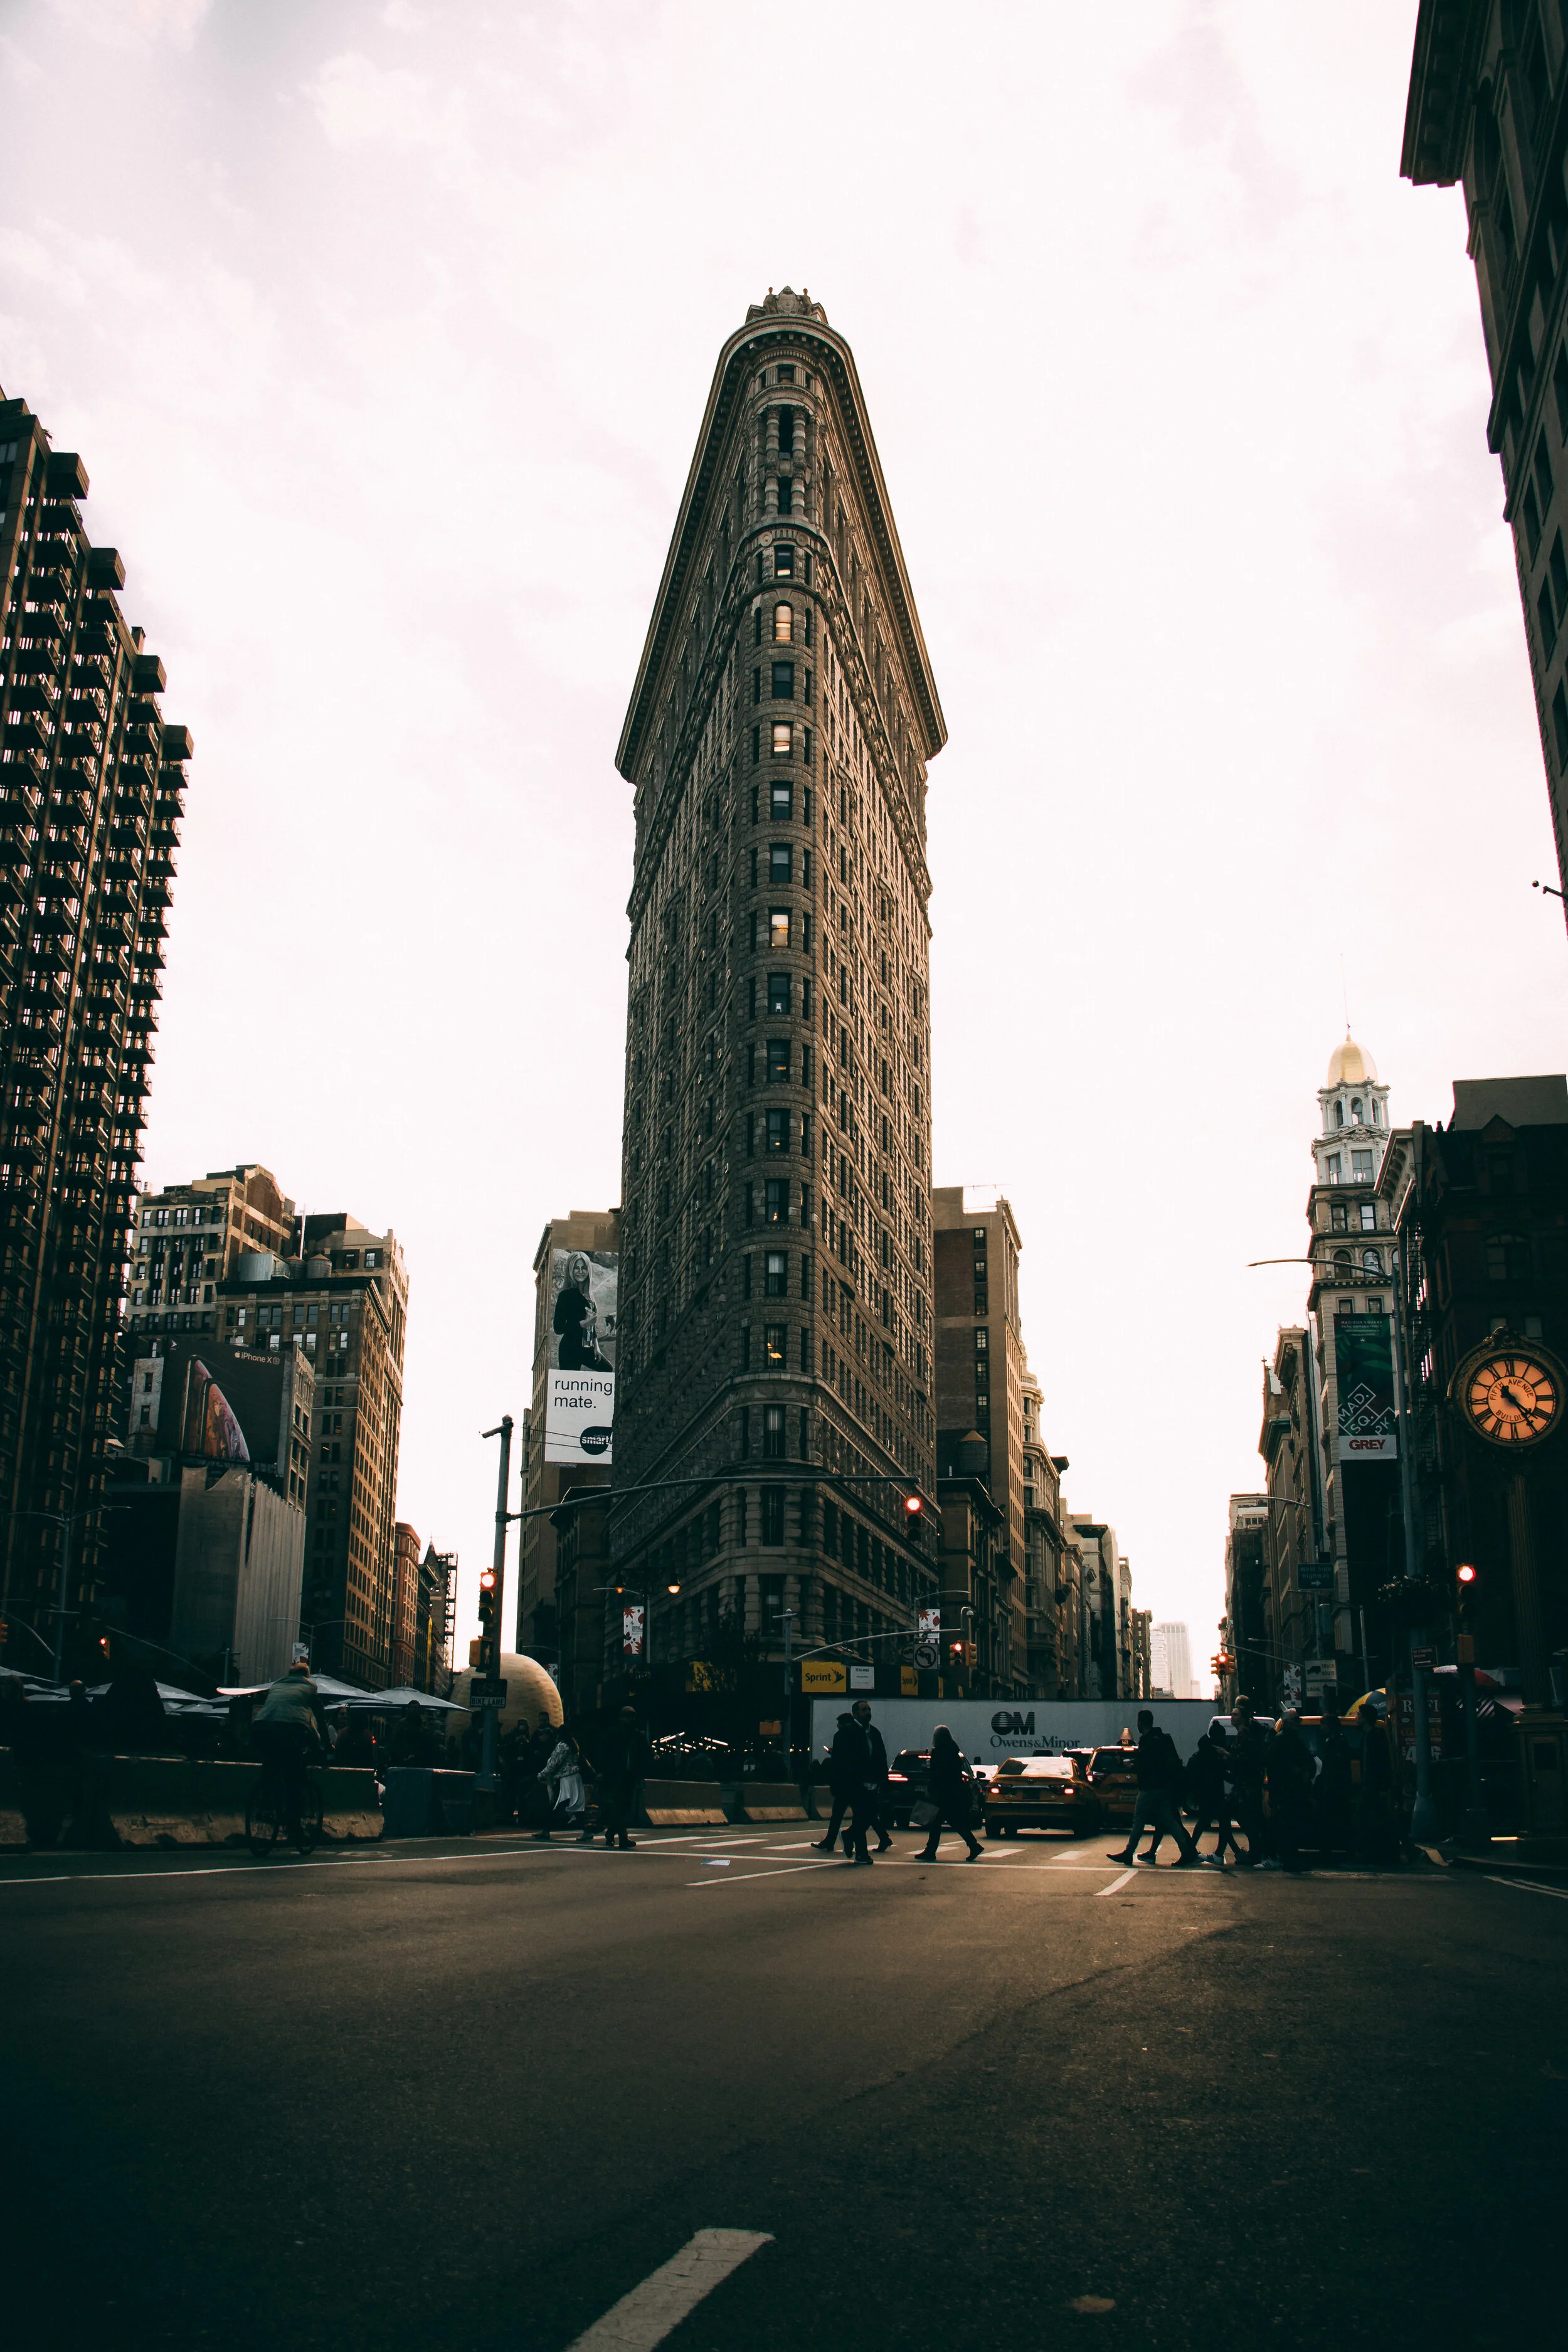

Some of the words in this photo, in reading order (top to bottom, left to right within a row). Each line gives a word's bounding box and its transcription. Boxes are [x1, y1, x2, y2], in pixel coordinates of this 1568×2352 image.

[241, 1352, 266, 1362] iPhone
[555, 1379, 613, 1396] running
[1490, 1382, 1503, 1401] FIFTH
[1508, 1379, 1534, 1399] AVENUE
[554, 1396, 596, 1409] mate.
[1338, 1394, 1369, 1422] MAD.
[1495, 1409, 1523, 1421] BUILDI
[1350, 1416, 1374, 1434] SQ.
[1348, 1439, 1386, 1450] GREY
[805, 1673, 831, 1683] Sprint
[471, 1697, 485, 1705] BIKE
